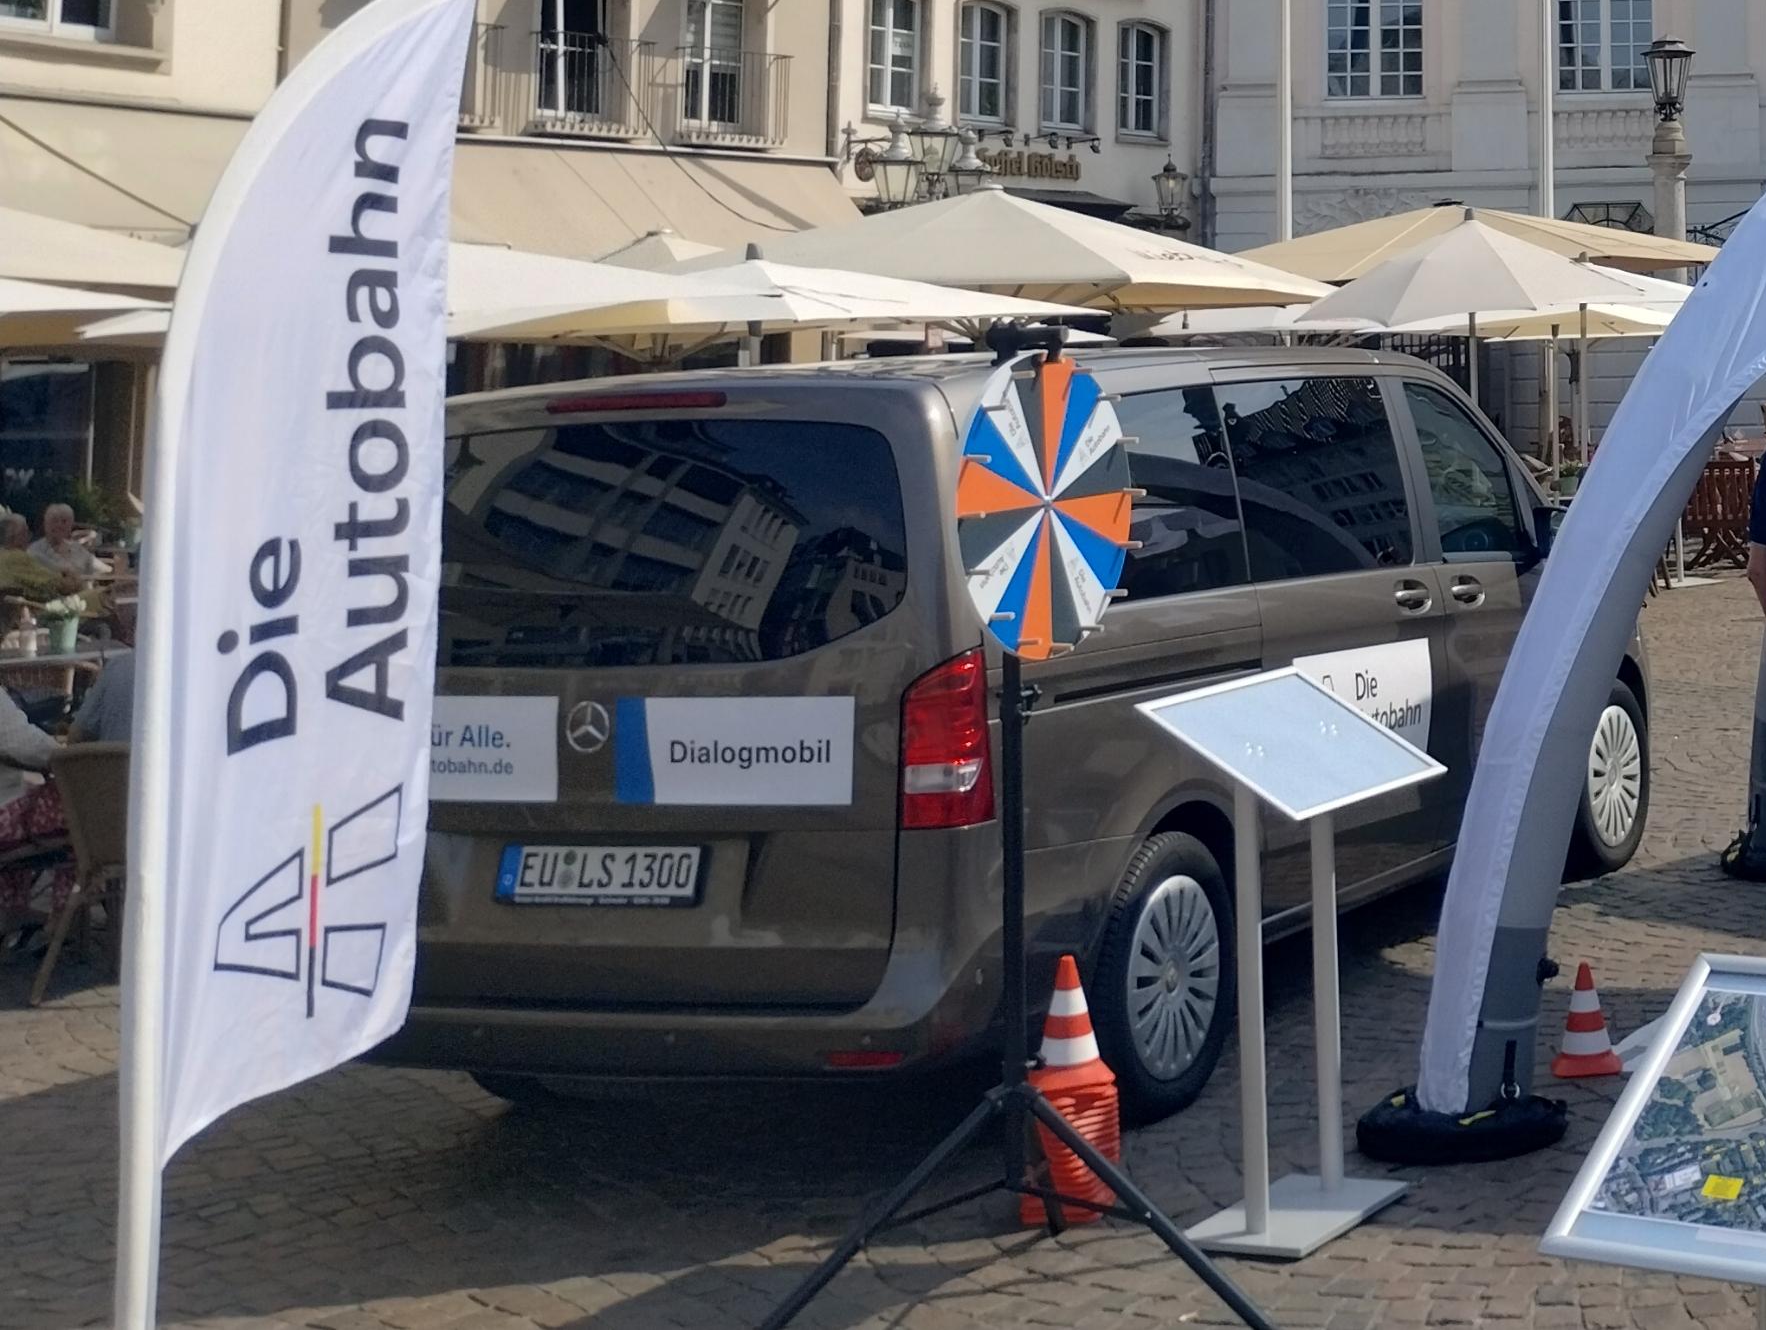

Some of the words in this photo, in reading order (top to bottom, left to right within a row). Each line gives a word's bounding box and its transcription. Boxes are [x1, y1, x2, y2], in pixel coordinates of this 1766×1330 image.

[326, 117, 411, 723] Autobahn
[217, 536, 301, 757] Die
[1355, 669, 1378, 701] Die
[1371, 698, 1421, 730] tobahn
[431, 724, 453, 746] ür
[459, 724, 511, 748] Alle.
[431, 757, 513, 775] tobahn.de
[669, 739, 831, 769] Dialogmobil
[519, 852, 559, 888] EU
[577, 852, 616, 888] LS
[621, 852, 693, 888] 1300
